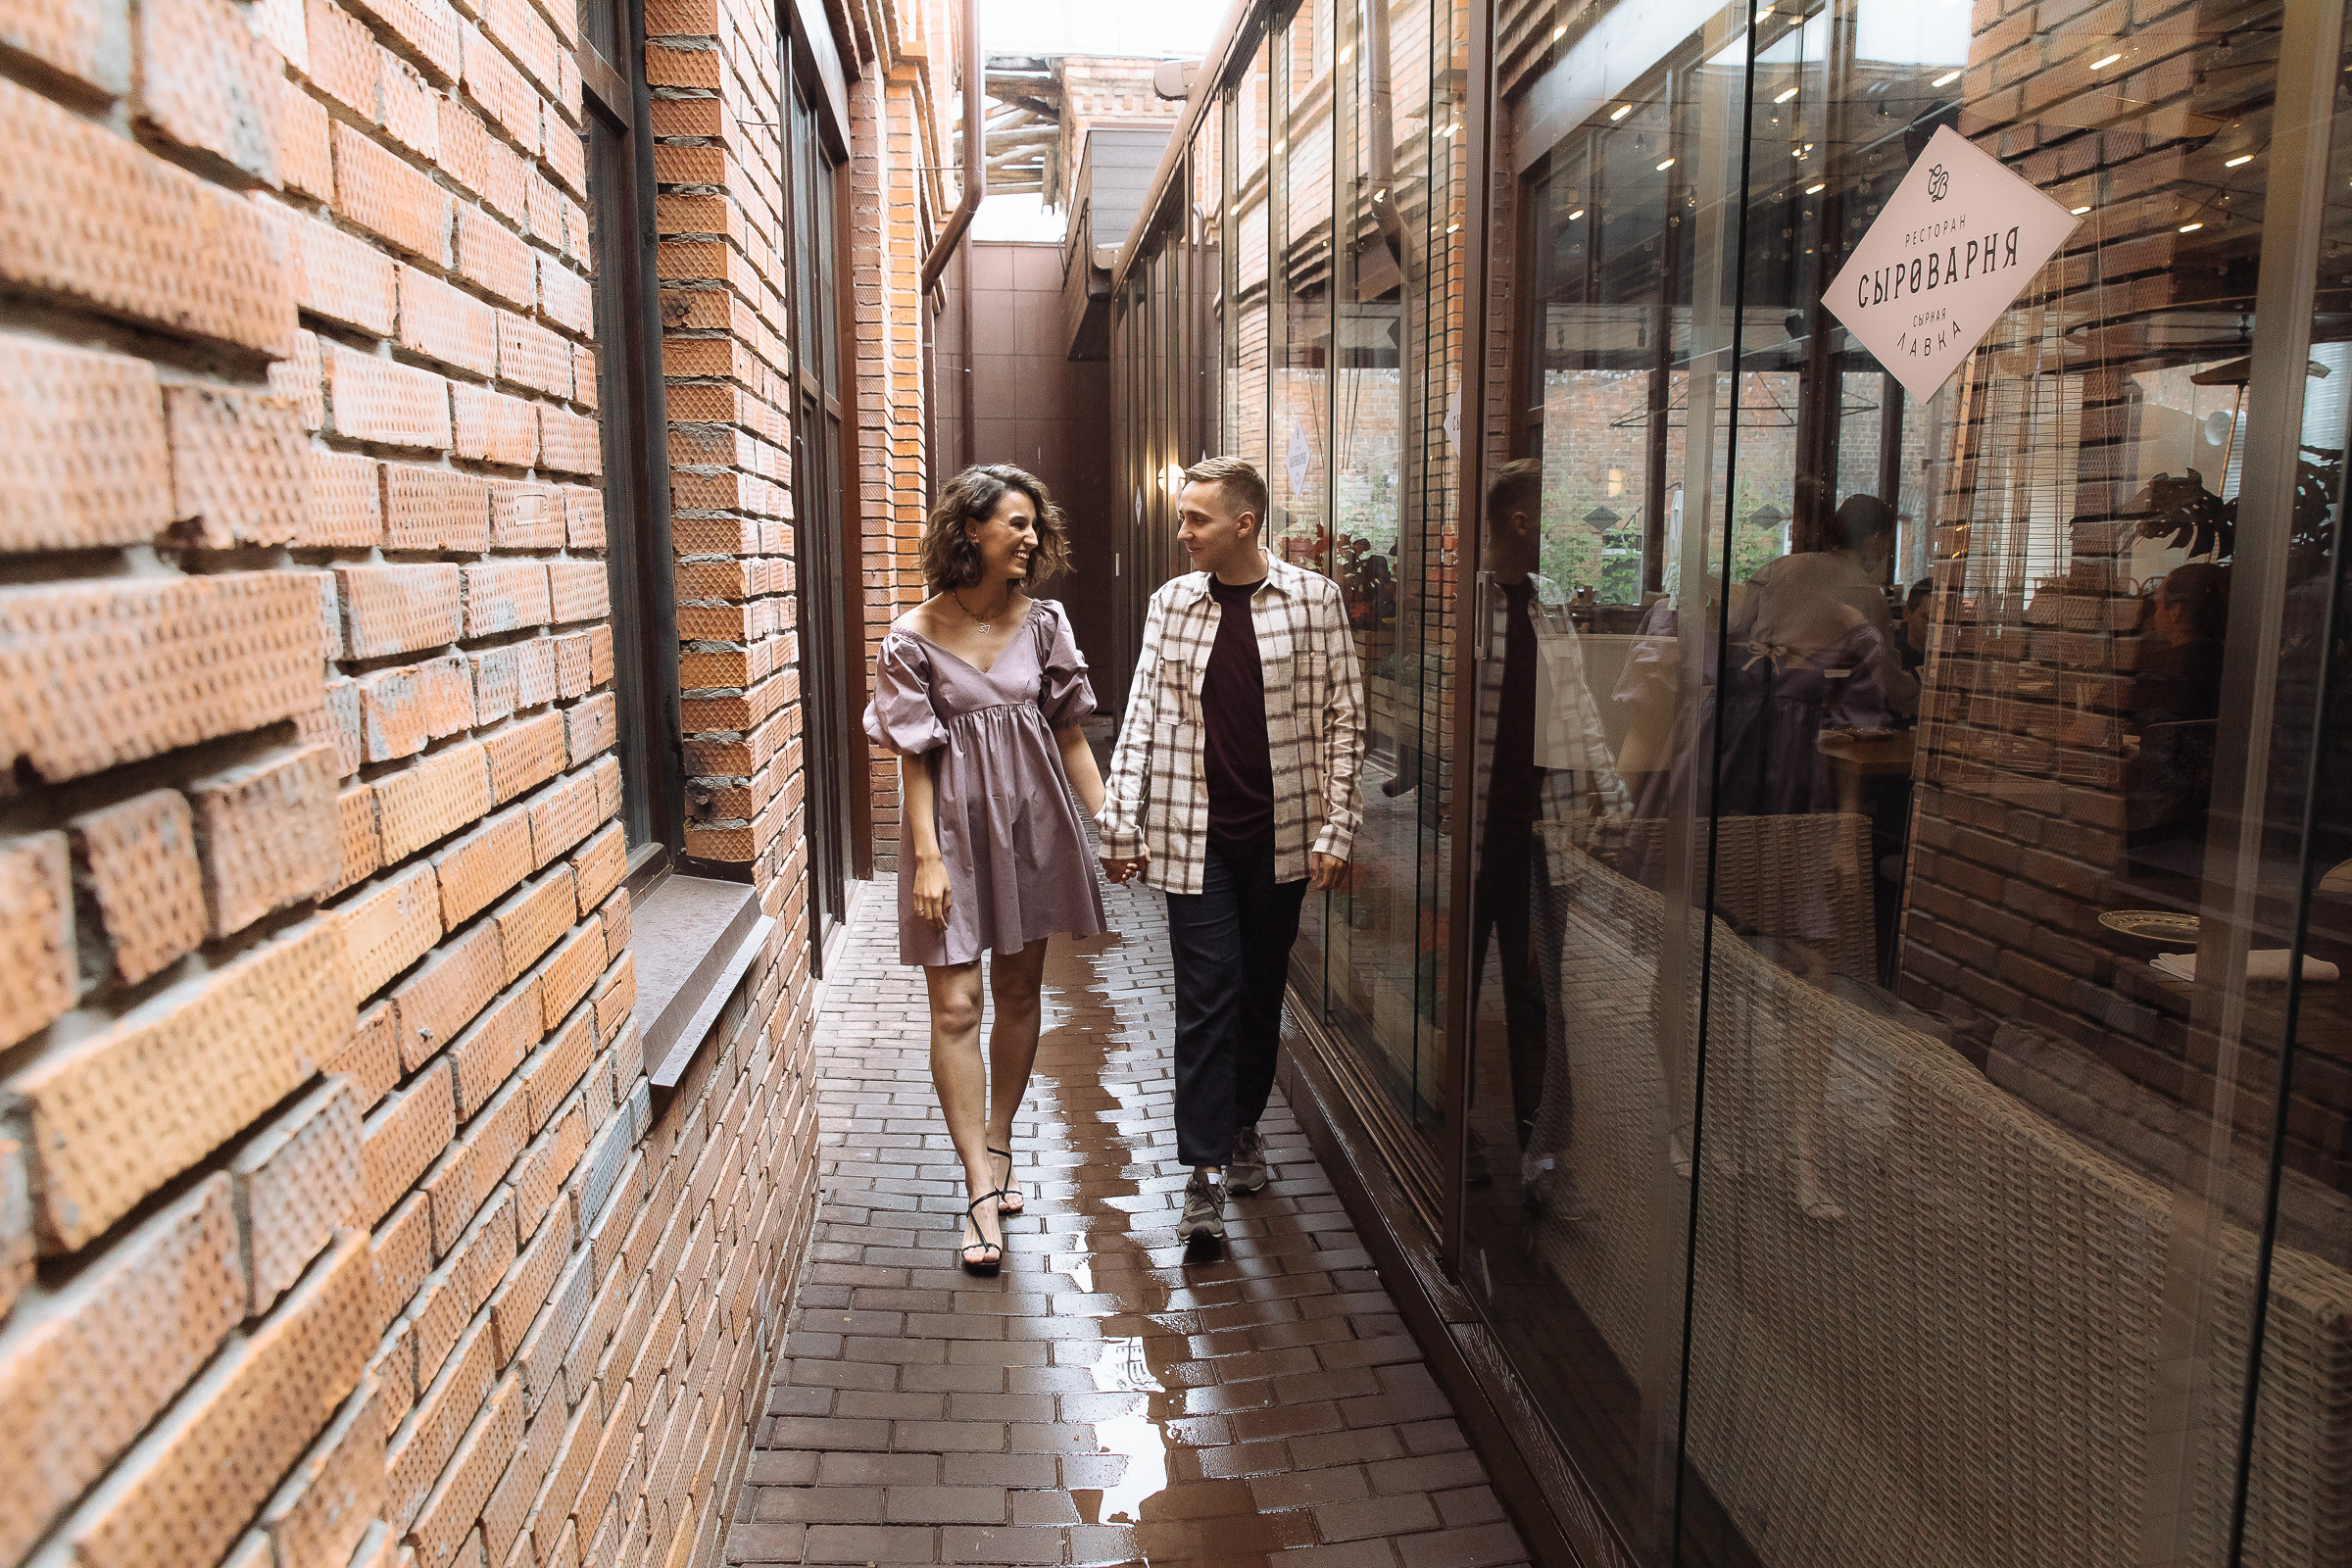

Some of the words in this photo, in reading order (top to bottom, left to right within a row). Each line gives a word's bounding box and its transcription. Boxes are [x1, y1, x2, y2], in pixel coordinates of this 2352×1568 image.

[1905, 214, 1966, 248] РЕСТОРАН
[1858, 225, 2020, 308] СЫРОВАРНЯ
[1913, 307, 1946, 327] СЫРНАЯ
[1897, 319, 1962, 357] ЛАВКА
